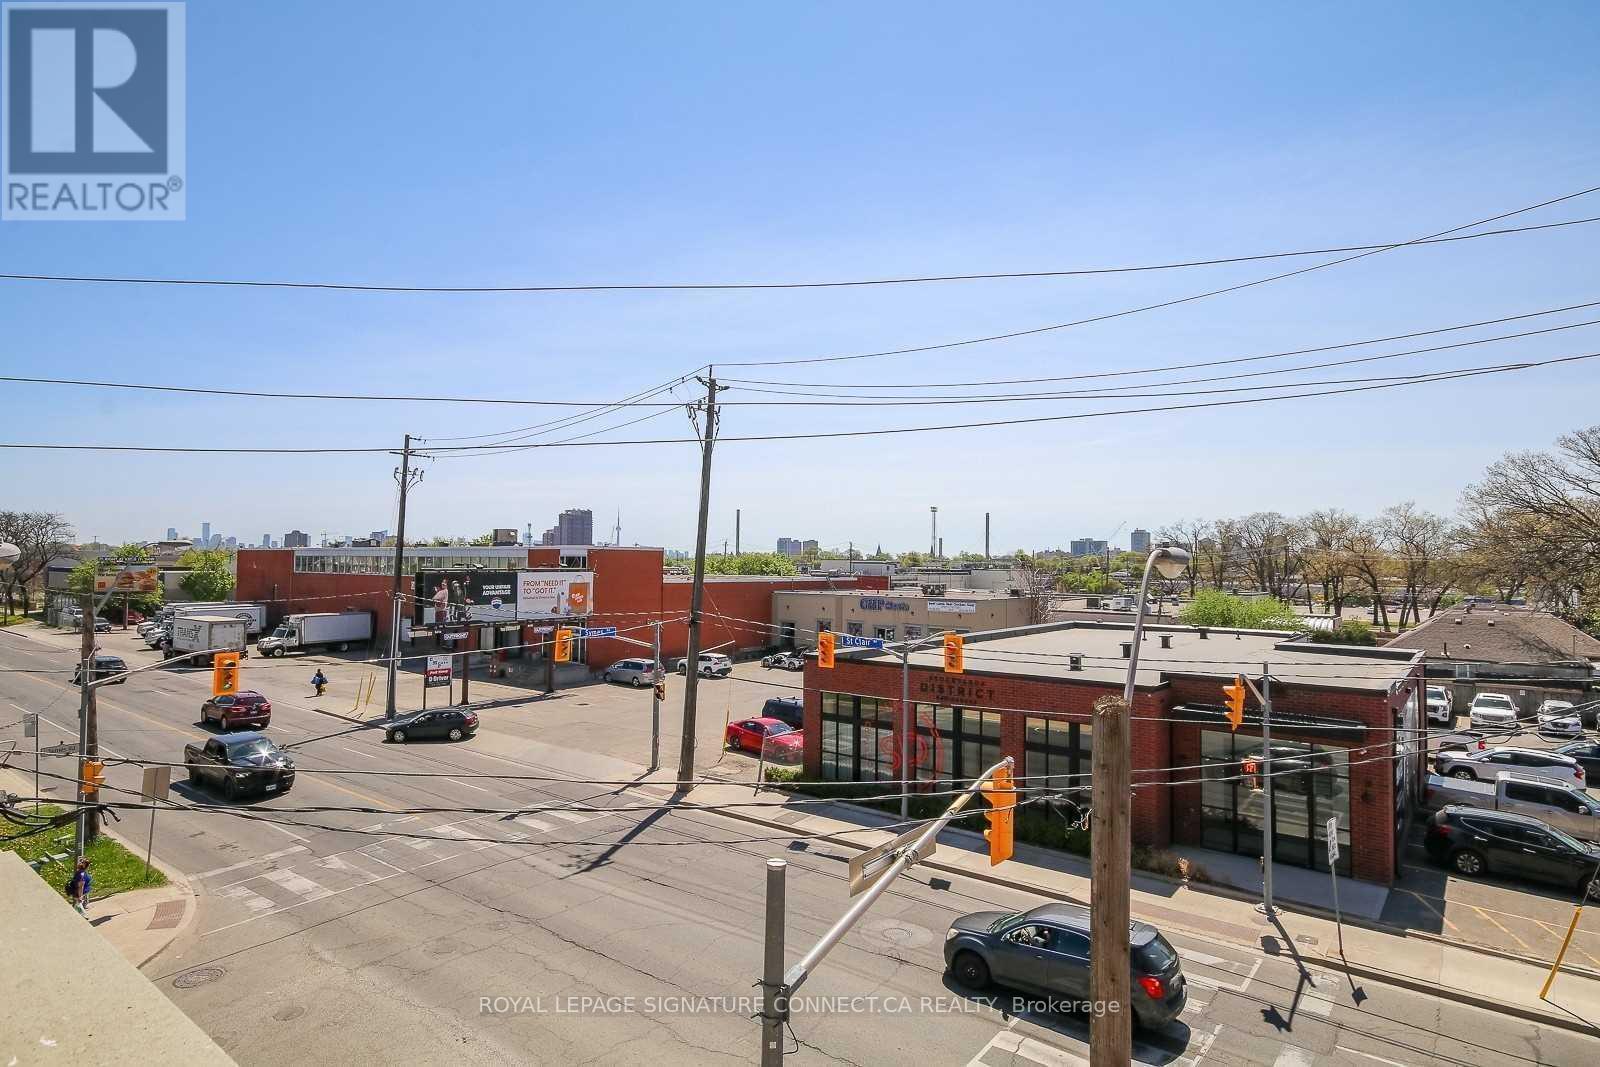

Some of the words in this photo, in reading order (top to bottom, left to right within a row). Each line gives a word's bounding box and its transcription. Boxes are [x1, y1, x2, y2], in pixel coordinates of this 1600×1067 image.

[846, 637, 853, 645] St
[854, 638, 870, 646] Clair
[920, 683, 994, 699] DISTRICT
